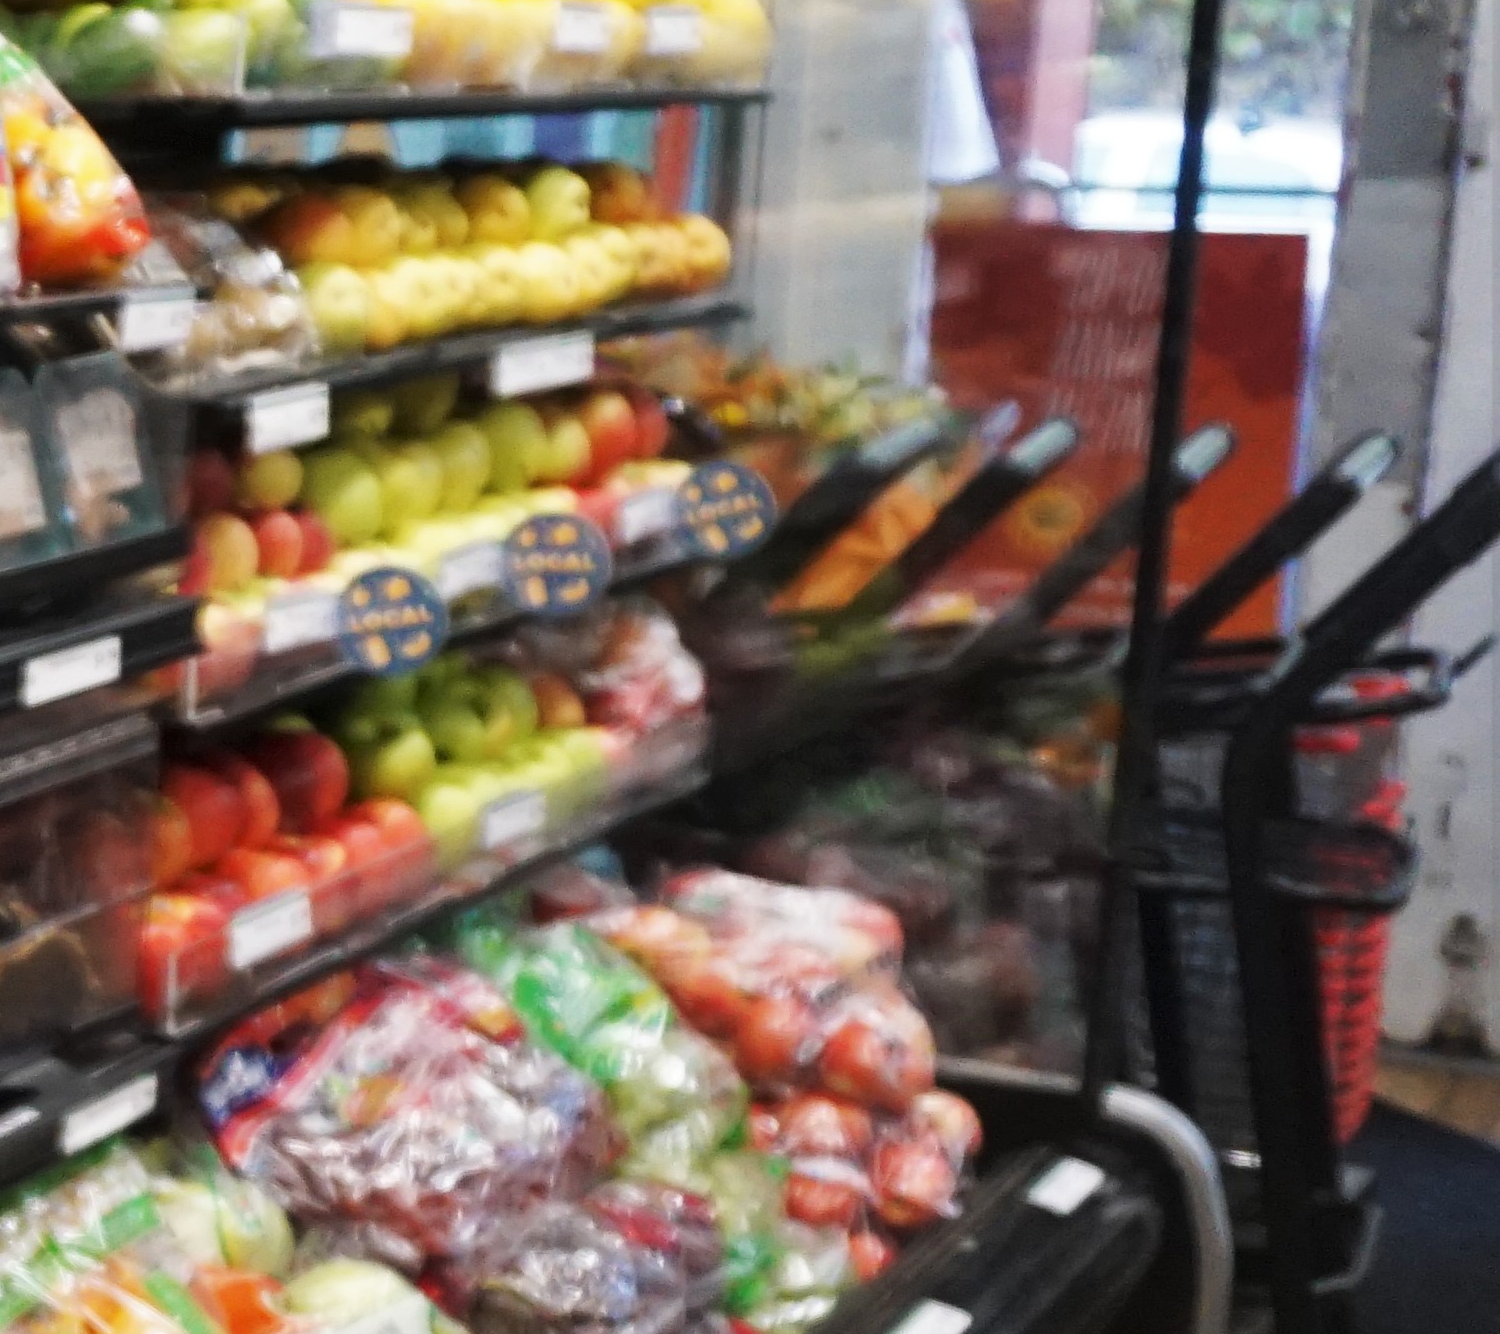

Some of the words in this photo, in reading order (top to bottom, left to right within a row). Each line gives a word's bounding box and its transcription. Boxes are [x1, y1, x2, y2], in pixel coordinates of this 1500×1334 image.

[687, 494, 762, 524] LOCAL
[513, 551, 594, 574] LOCAL
[350, 603, 434, 633] LOCAL
